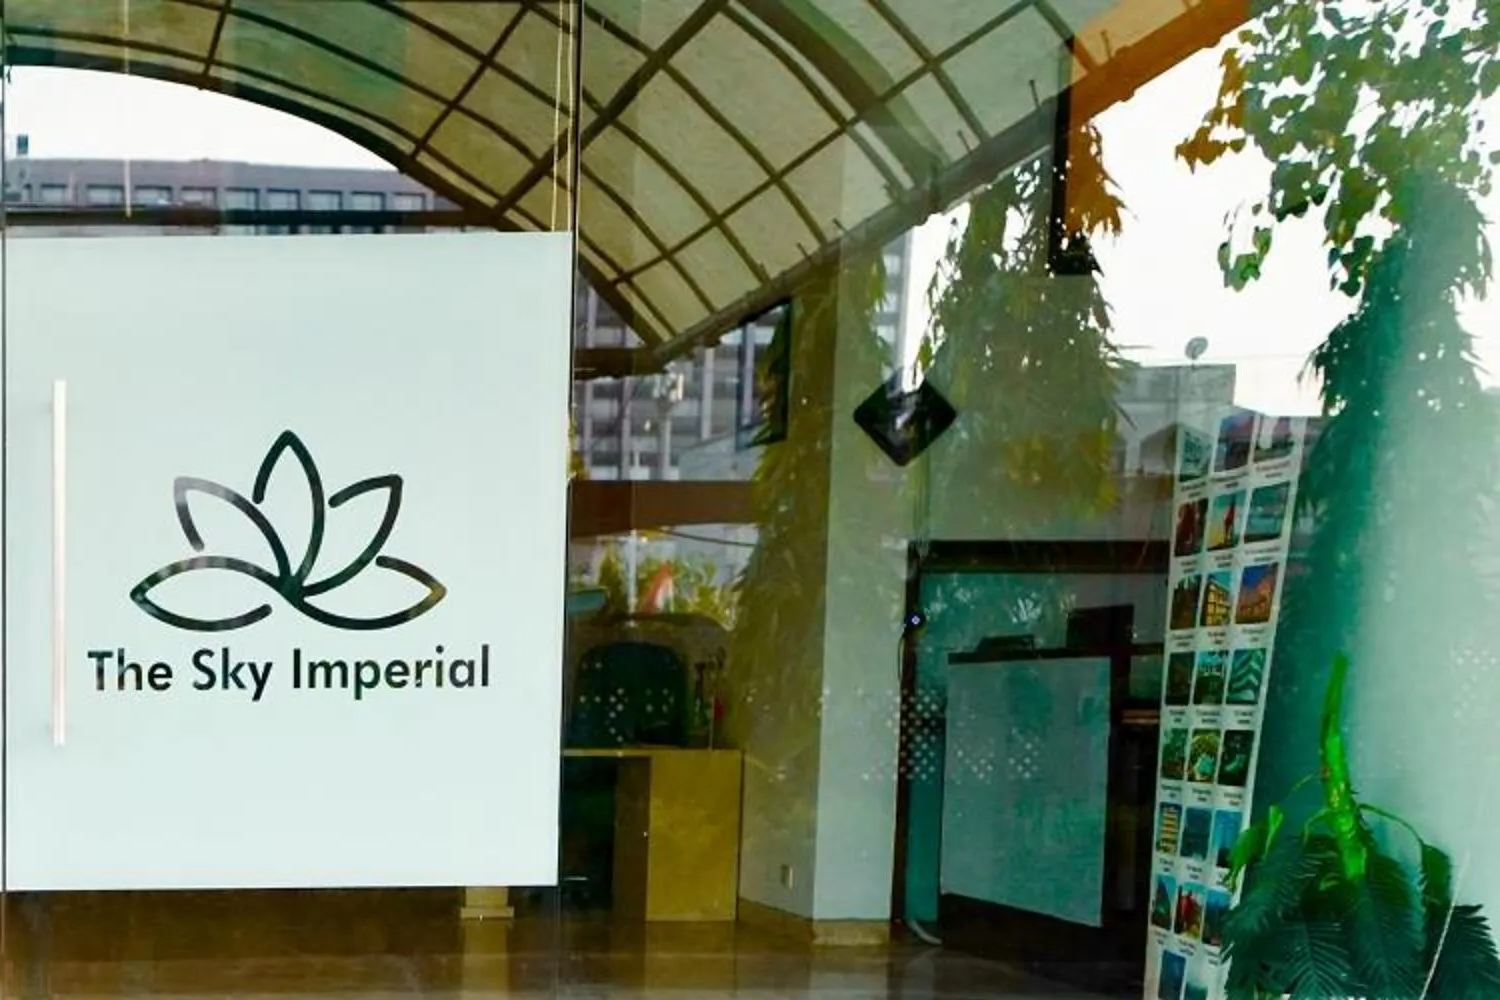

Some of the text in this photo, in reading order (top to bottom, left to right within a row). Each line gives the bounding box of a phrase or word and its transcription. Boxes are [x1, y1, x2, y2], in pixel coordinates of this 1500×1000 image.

[87, 644, 489, 702] The Sky Imperial
